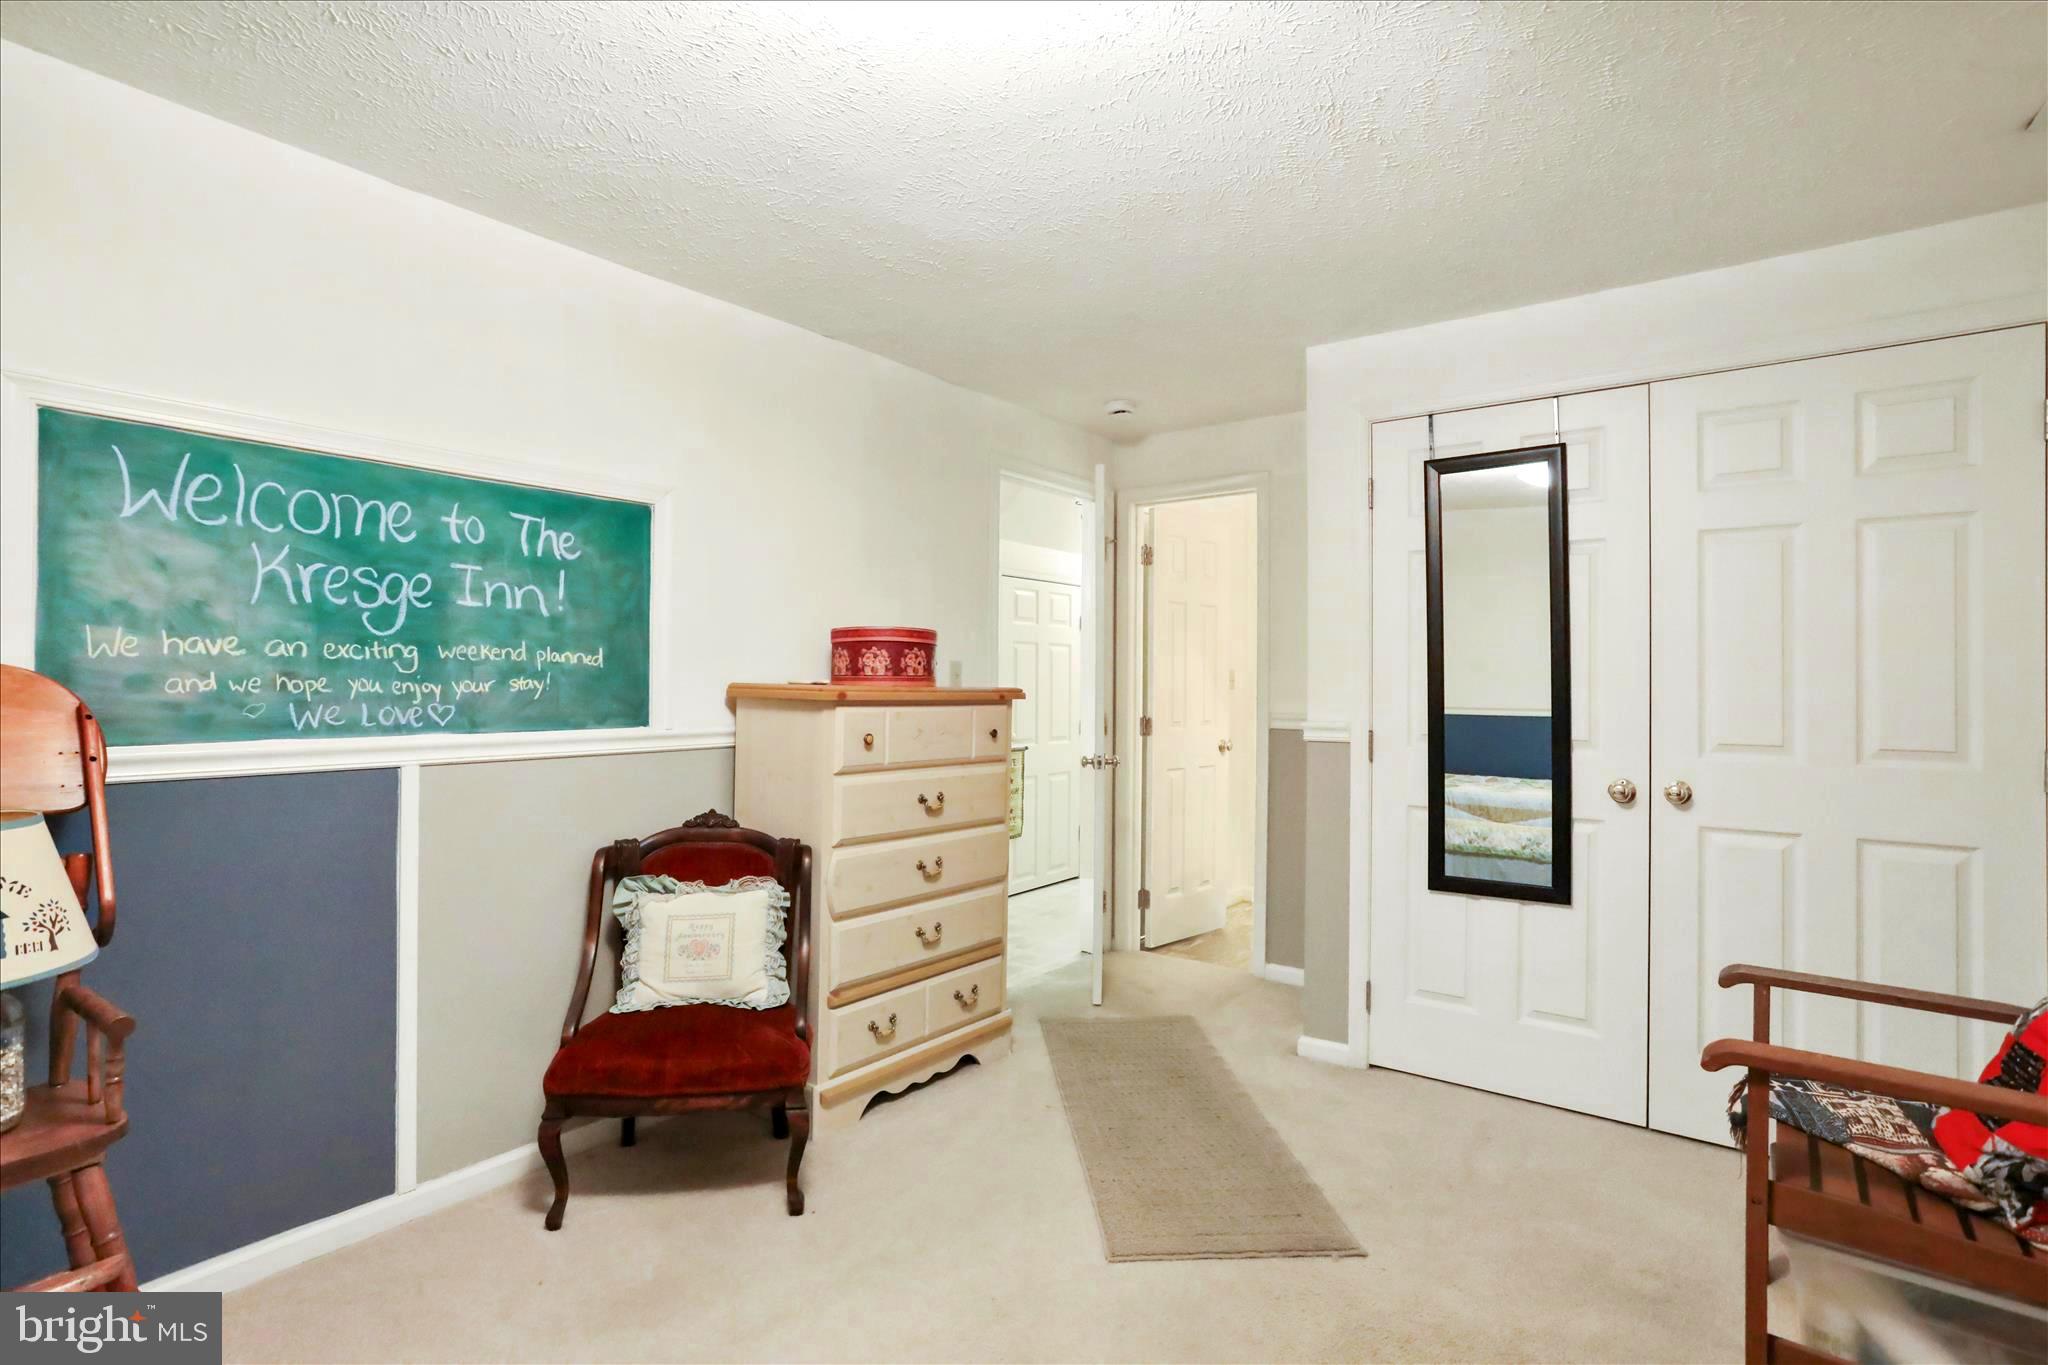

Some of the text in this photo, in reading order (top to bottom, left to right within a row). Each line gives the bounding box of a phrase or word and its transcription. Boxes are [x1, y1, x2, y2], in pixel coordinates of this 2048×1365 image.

[111, 445, 581, 560] Welcome to The
[250, 541, 565, 636] Kresge Inn!
[86, 624, 604, 673] We have an exciting weekend planned
[165, 671, 551, 704] and we hope you enjoy your stay!
[289, 703, 424, 731] We Love
